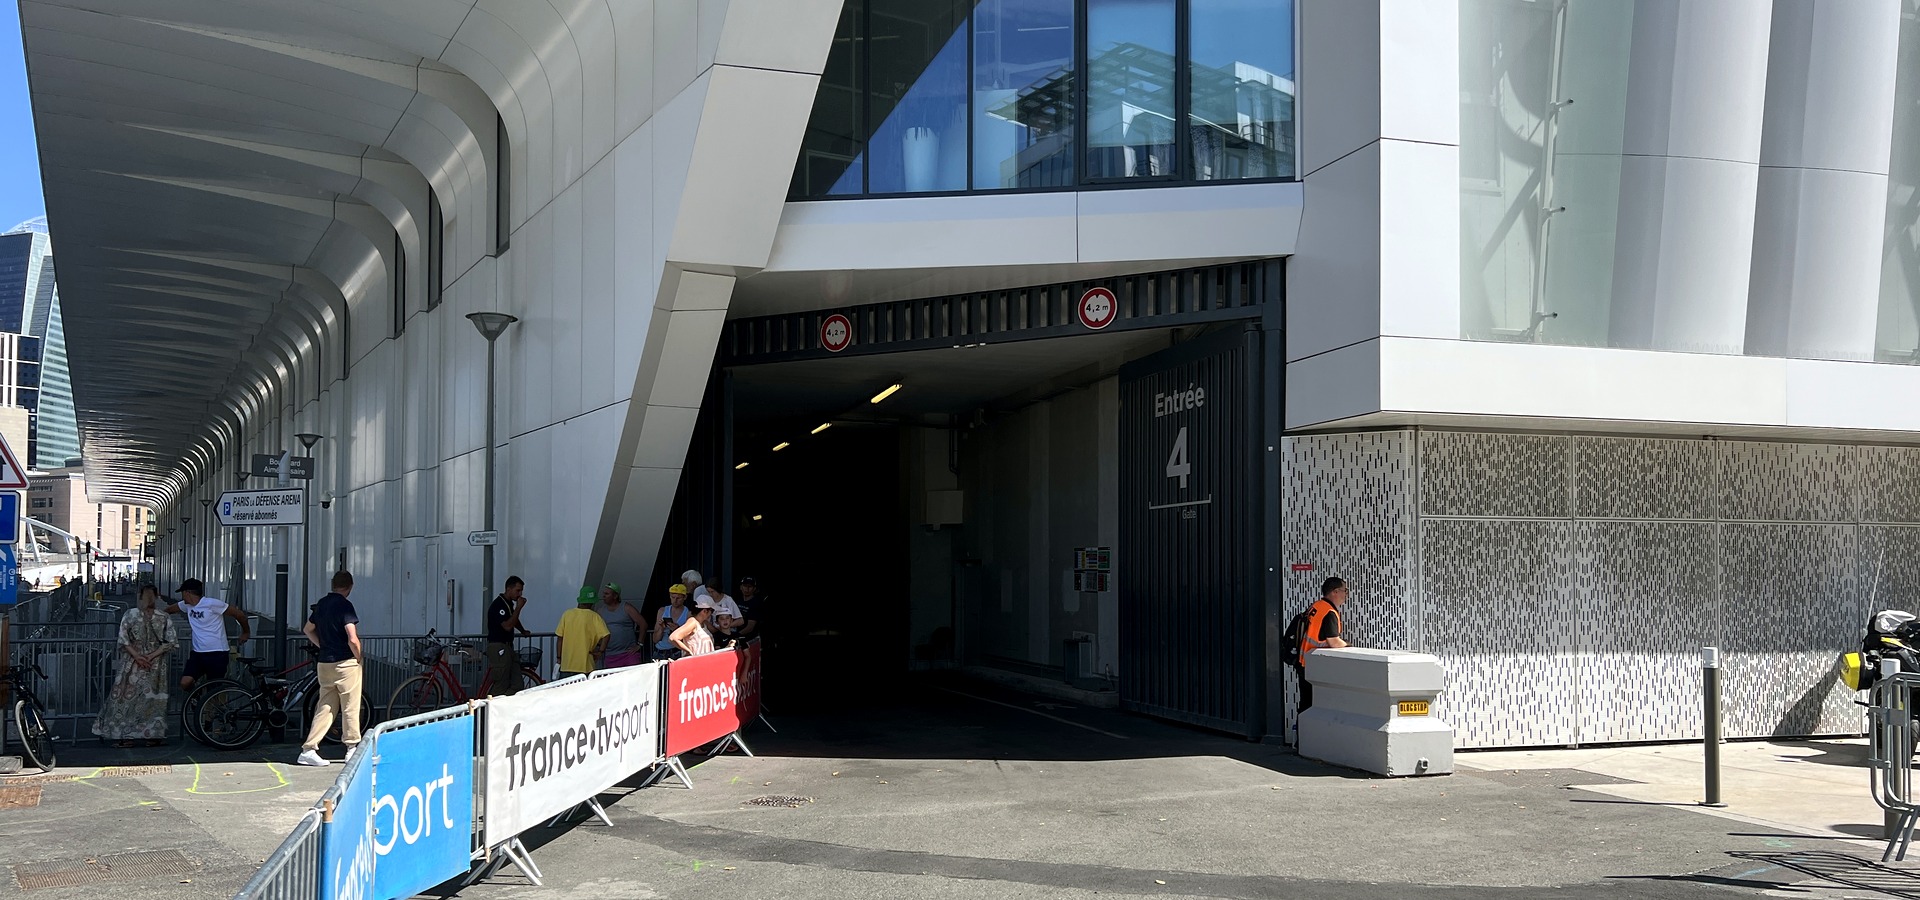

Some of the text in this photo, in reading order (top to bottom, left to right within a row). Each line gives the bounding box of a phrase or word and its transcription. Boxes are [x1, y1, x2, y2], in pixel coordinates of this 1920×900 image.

[1086, 304, 1100, 312] 4,2
[1155, 382, 1205, 418] Entrée
[269, 458, 301, 467] Bouard
[1166, 426, 1191, 489] 4
[232, 496, 250, 507] PARIS
[256, 493, 281, 507] DÉFENSE
[281, 494, 301, 506] ARENA
[255, 509, 278, 520] abonnés
[1182, 509, 1197, 519] Gate
